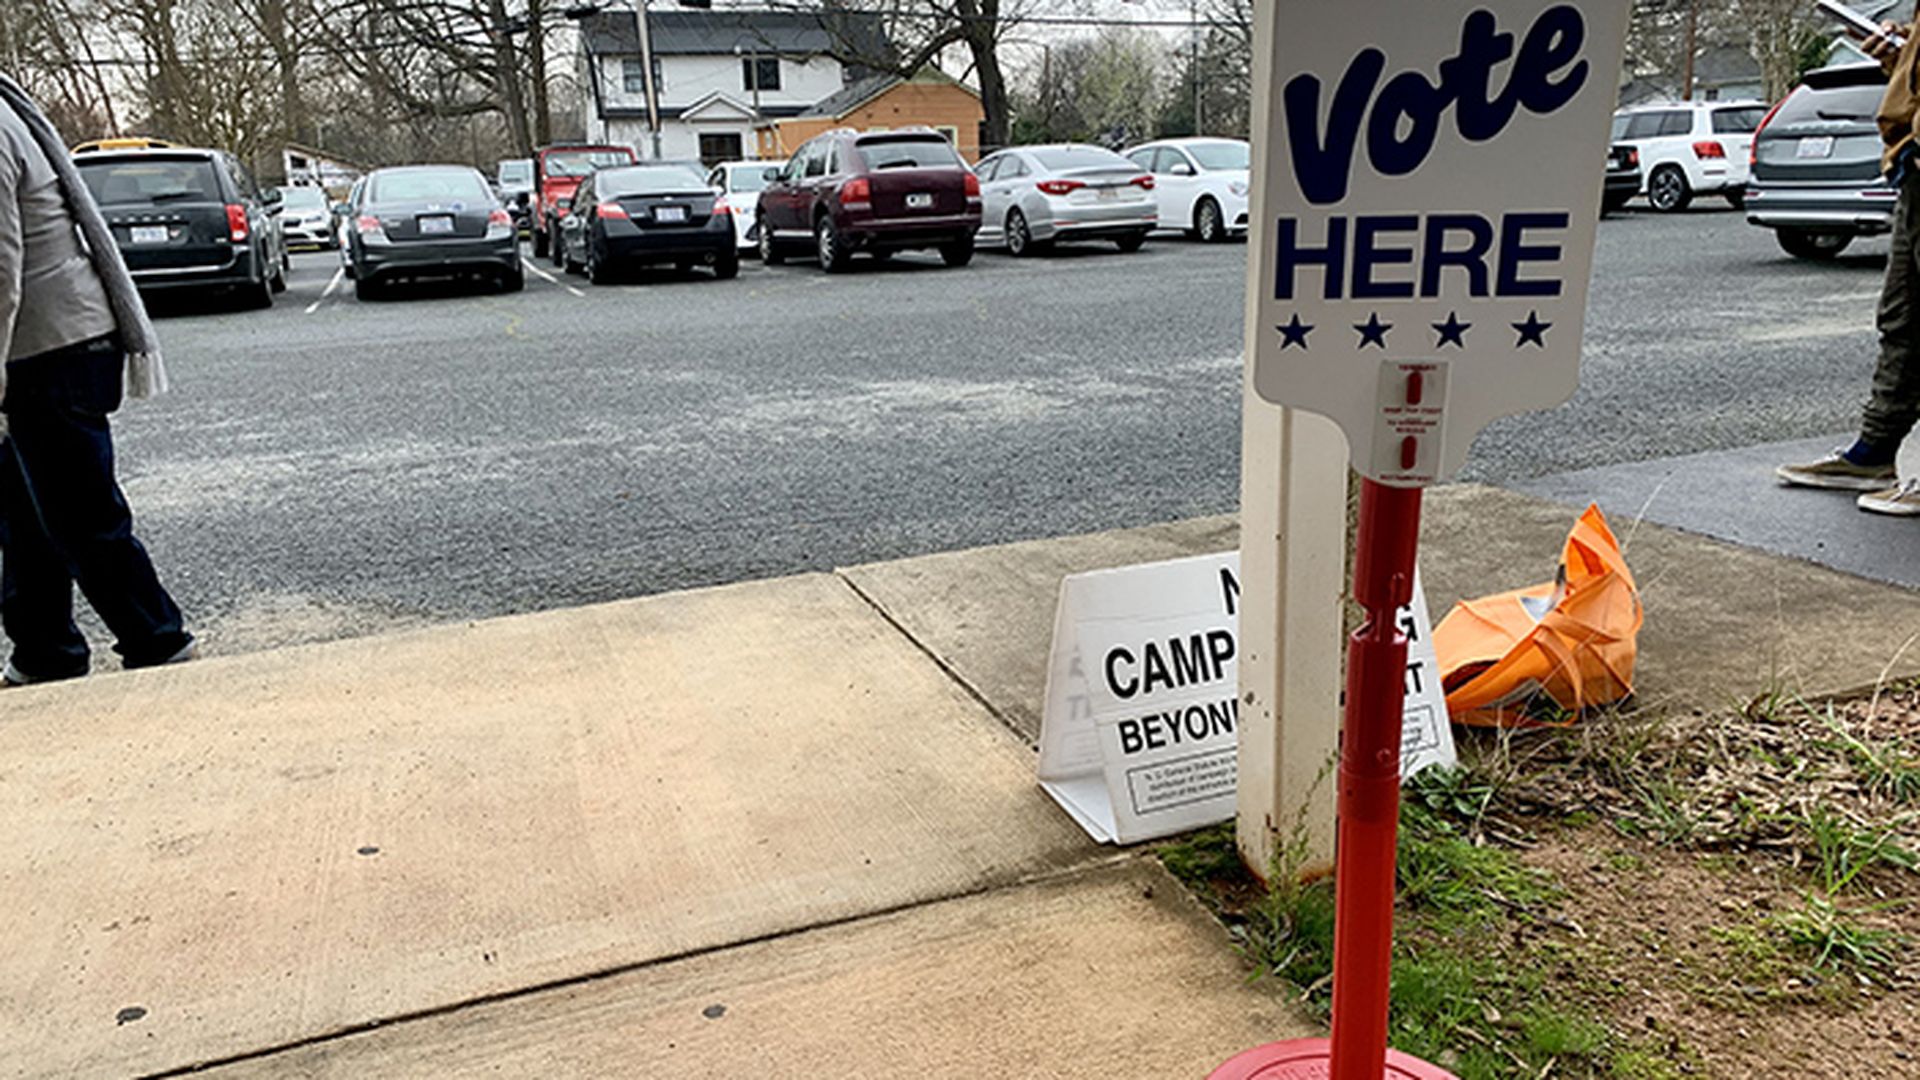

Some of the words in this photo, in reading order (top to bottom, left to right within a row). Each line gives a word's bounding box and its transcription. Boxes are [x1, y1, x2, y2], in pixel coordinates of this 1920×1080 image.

[1283, 5, 1589, 206] Vote
[1273, 212, 1570, 300] HERE
[1105, 630, 1236, 699] CAMP
[1118, 698, 1238, 755] BEYON
